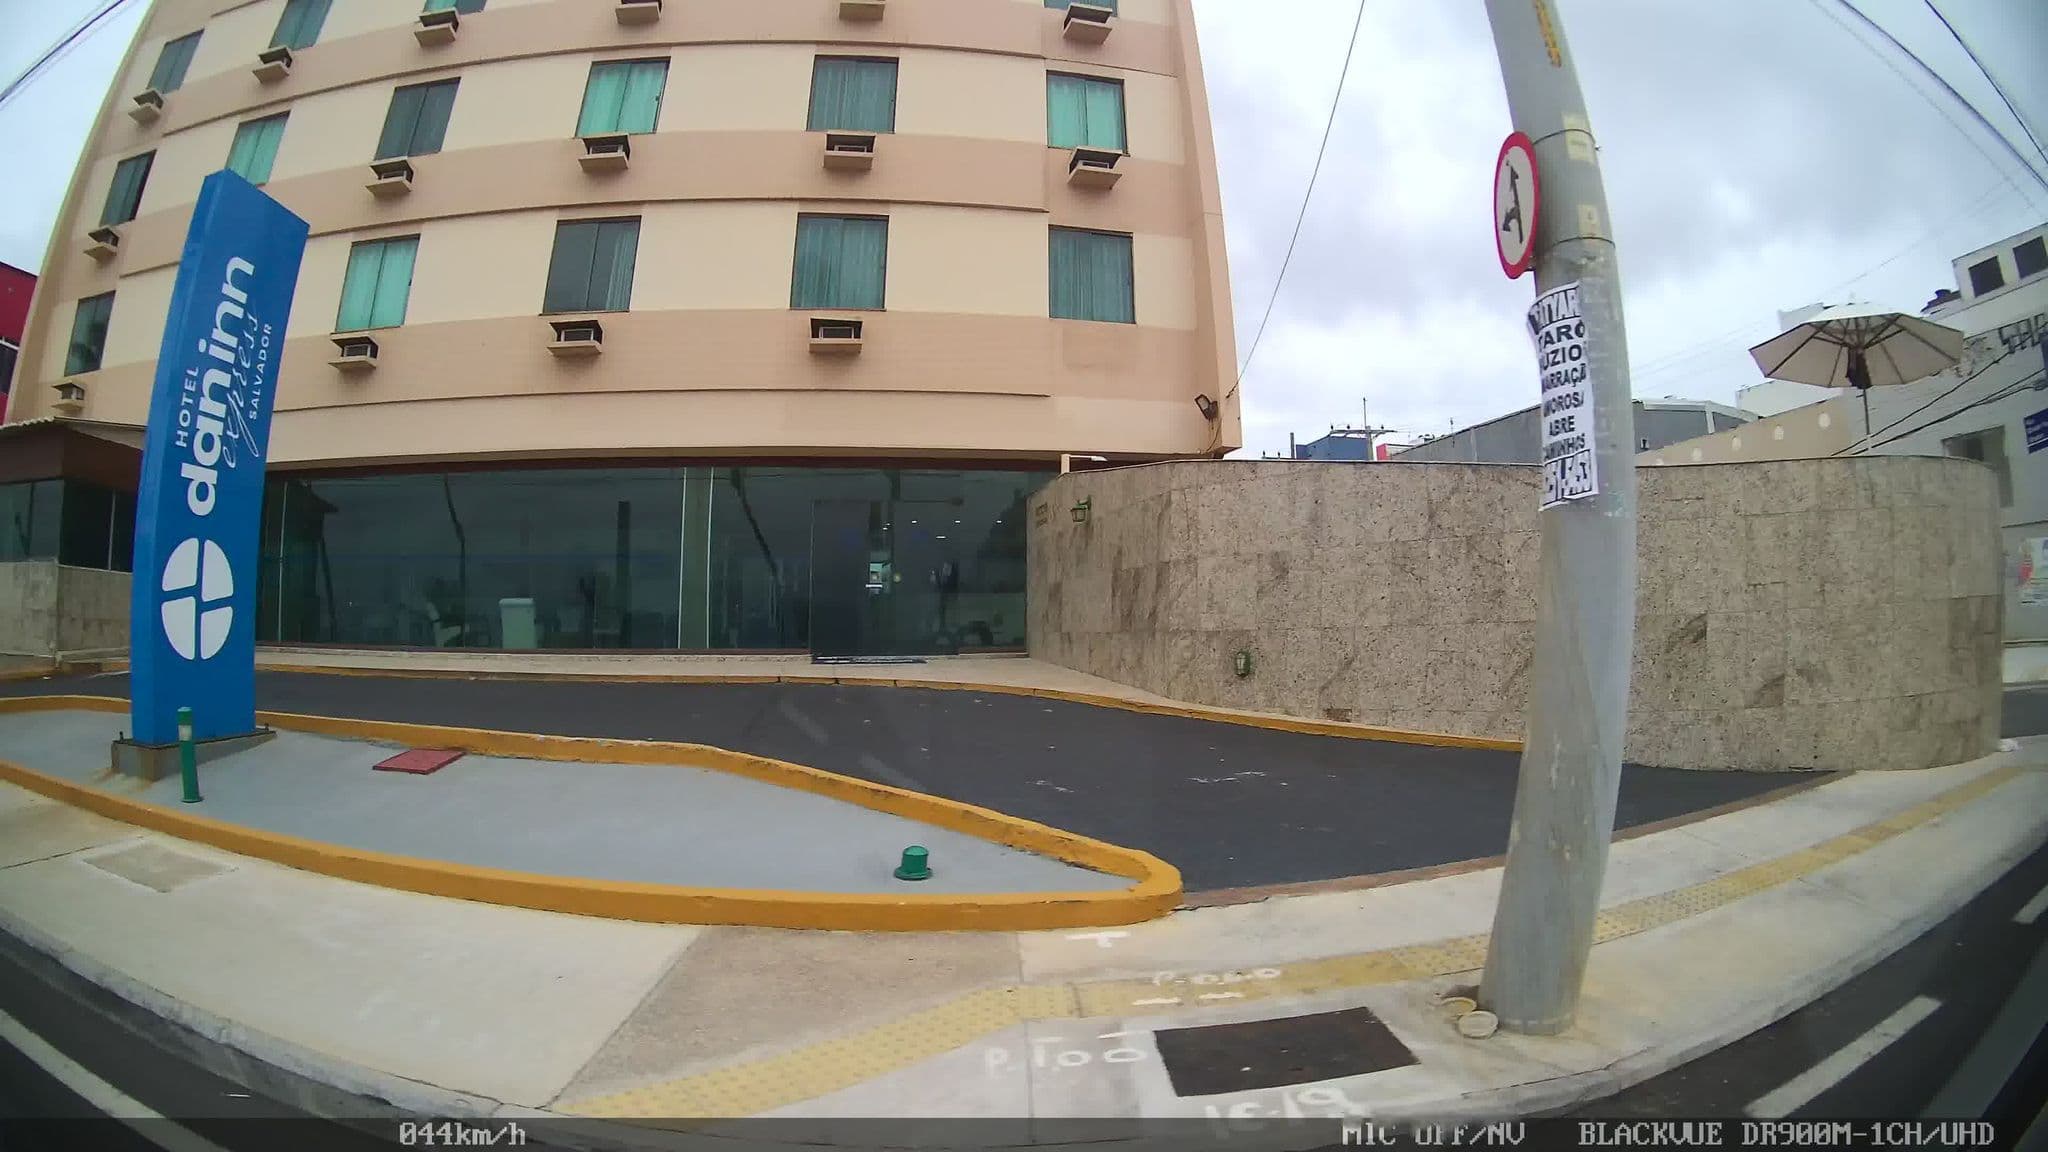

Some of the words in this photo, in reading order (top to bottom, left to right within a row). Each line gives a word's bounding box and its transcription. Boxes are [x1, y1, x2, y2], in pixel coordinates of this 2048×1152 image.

[175, 366, 199, 448] HOTEL
[222, 310, 260, 468] express
[249, 323, 272, 420] SALVADOR
